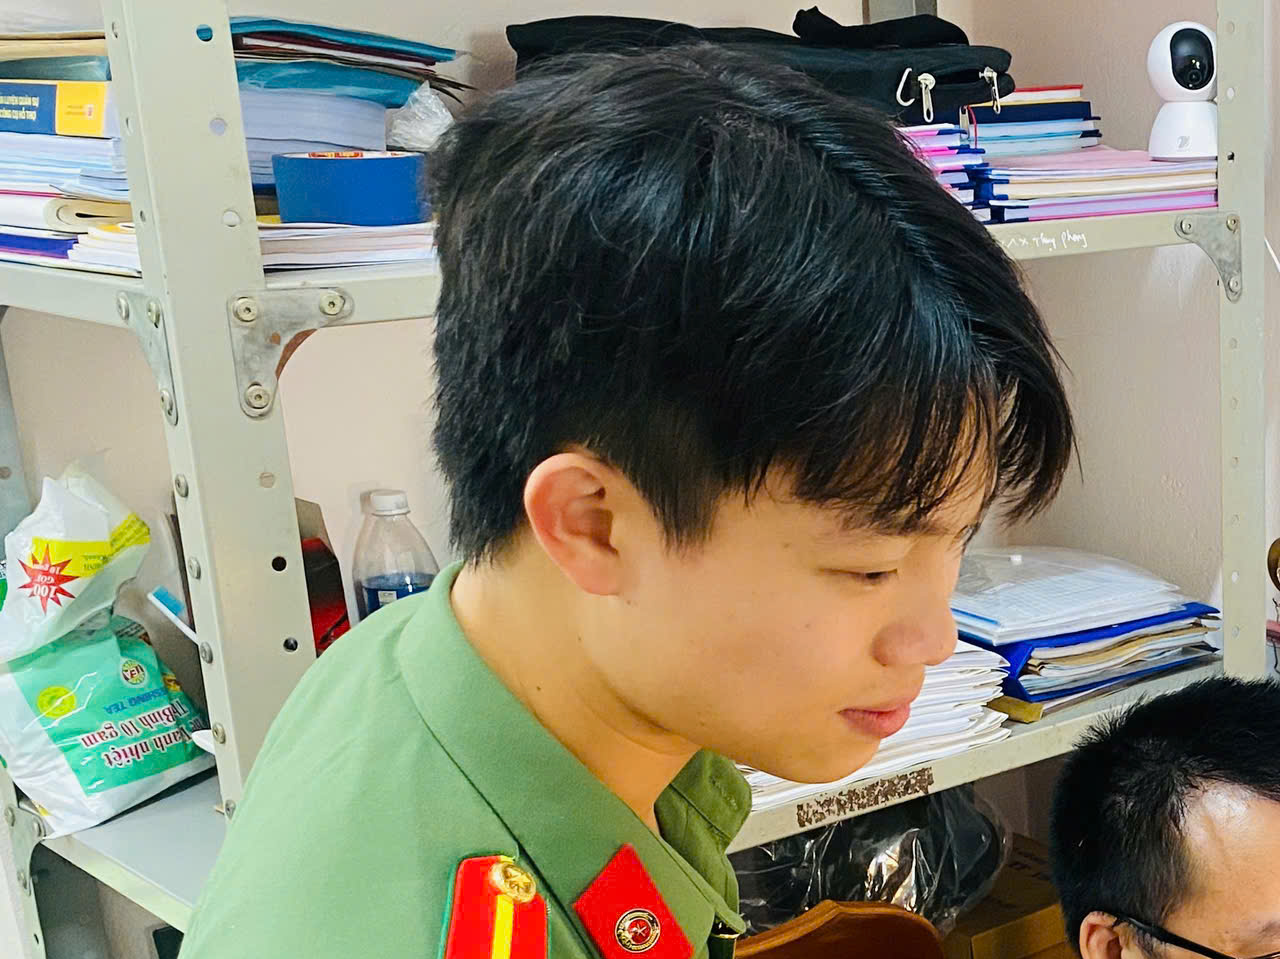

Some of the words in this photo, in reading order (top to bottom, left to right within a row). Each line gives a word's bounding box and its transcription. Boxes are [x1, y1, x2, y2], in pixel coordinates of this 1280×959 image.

[33, 584, 57, 597] 100
[80, 722, 119, 748] gam
[119, 720, 141, 737] 10
[103, 741, 151, 767] nhiệt
